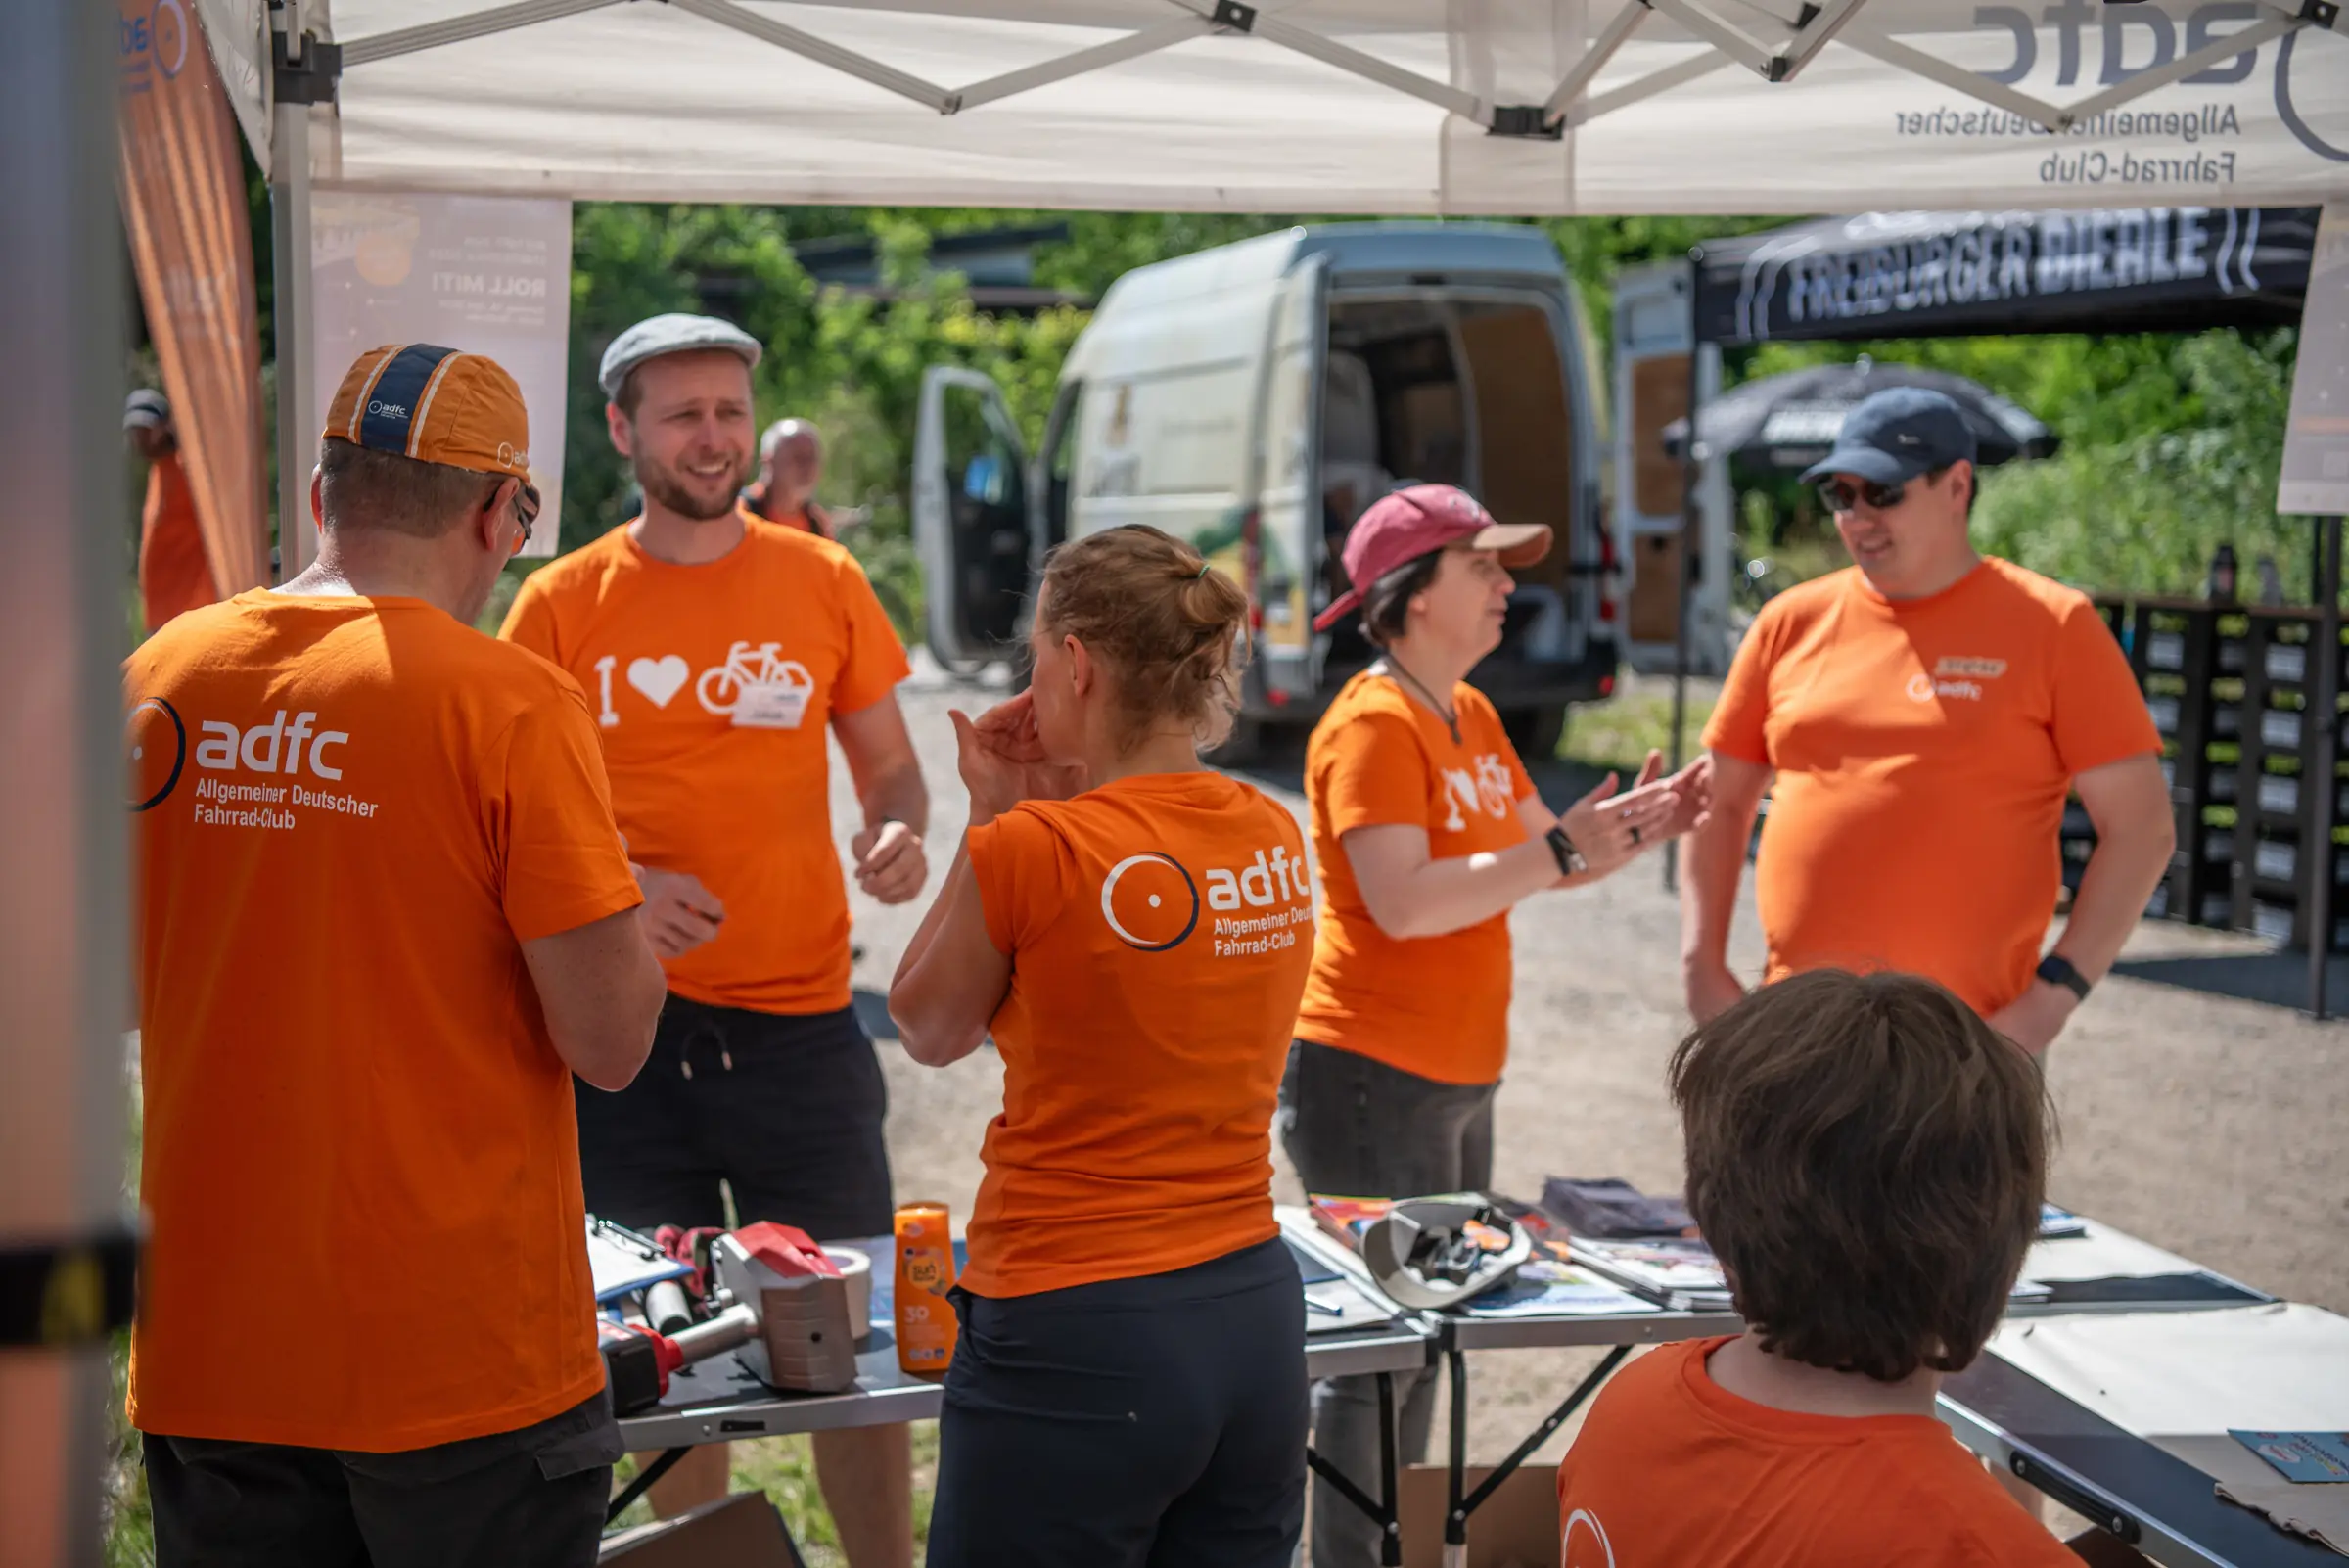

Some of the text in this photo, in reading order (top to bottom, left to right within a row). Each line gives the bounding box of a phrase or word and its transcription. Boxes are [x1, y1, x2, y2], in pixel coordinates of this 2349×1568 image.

[382, 404, 406, 415] adfc
[593, 655, 620, 726] I
[196, 710, 349, 781] adfc
[196, 777, 379, 818] Allgemeiner Deutscher
[195, 803, 296, 830] Fahrrad-Club
[1206, 846, 1311, 911] adfc
[1214, 911, 1290, 938] Allgemeiner
[1214, 931, 1296, 957] Fahrrad-Club
